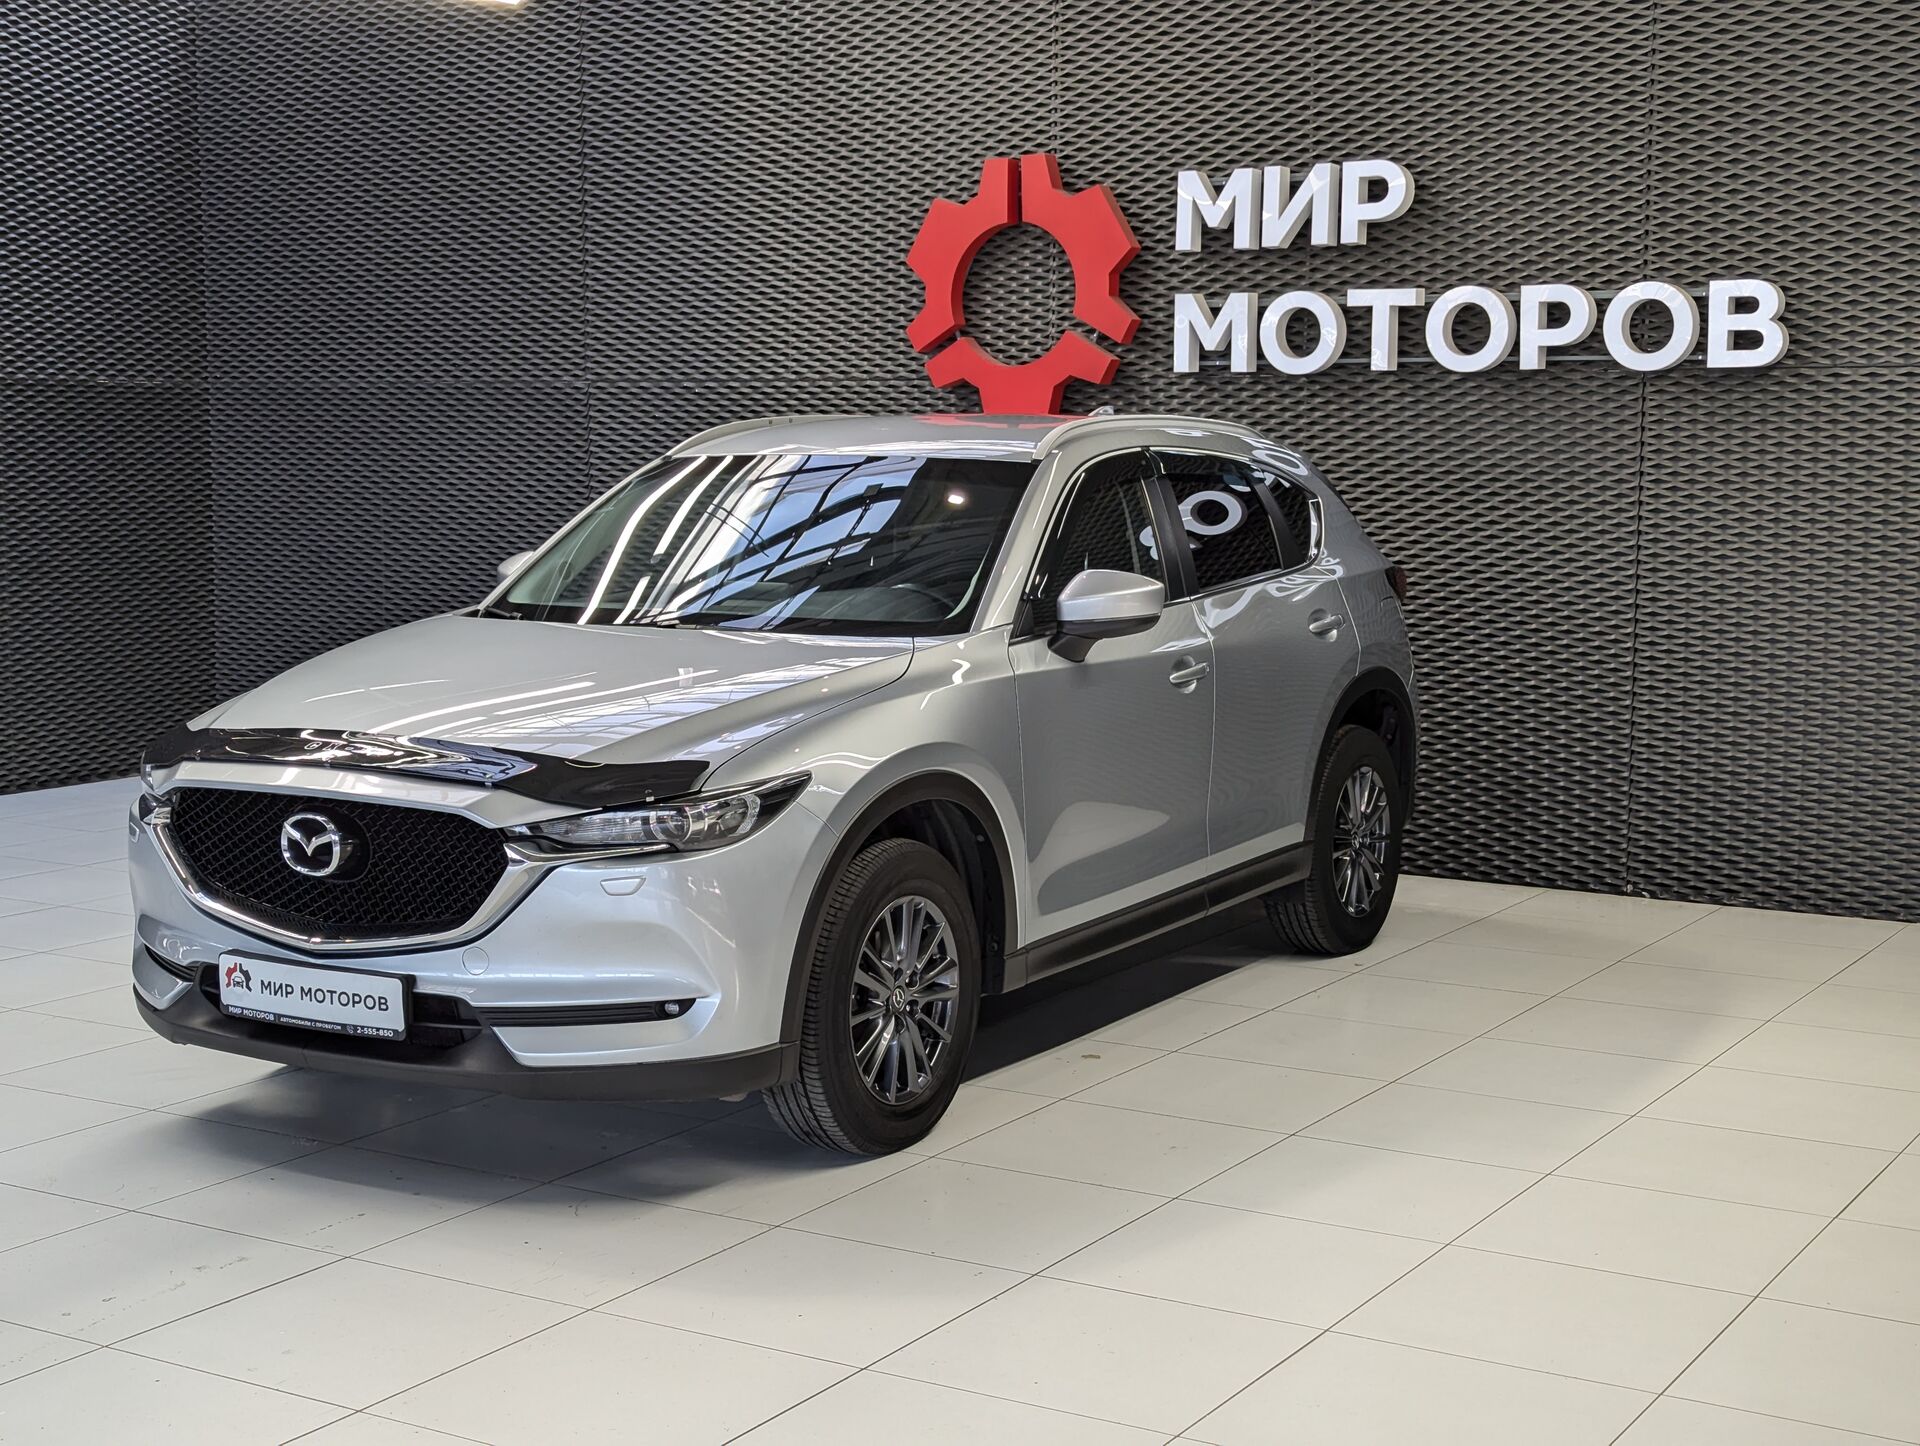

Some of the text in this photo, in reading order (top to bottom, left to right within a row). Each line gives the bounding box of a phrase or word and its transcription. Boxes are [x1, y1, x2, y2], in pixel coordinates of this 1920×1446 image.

[1175, 159, 1415, 251] МИР
[1173, 279, 1789, 375] МОТОРОВ
[260, 979, 389, 1012] МИР МОТОРОВ
[228, 1006, 275, 1021] МИР МОТОРОВ
[280, 1016, 311, 1026] АВТОМОБИЛИ
[356, 1026, 394, 1037] 2-555-850
